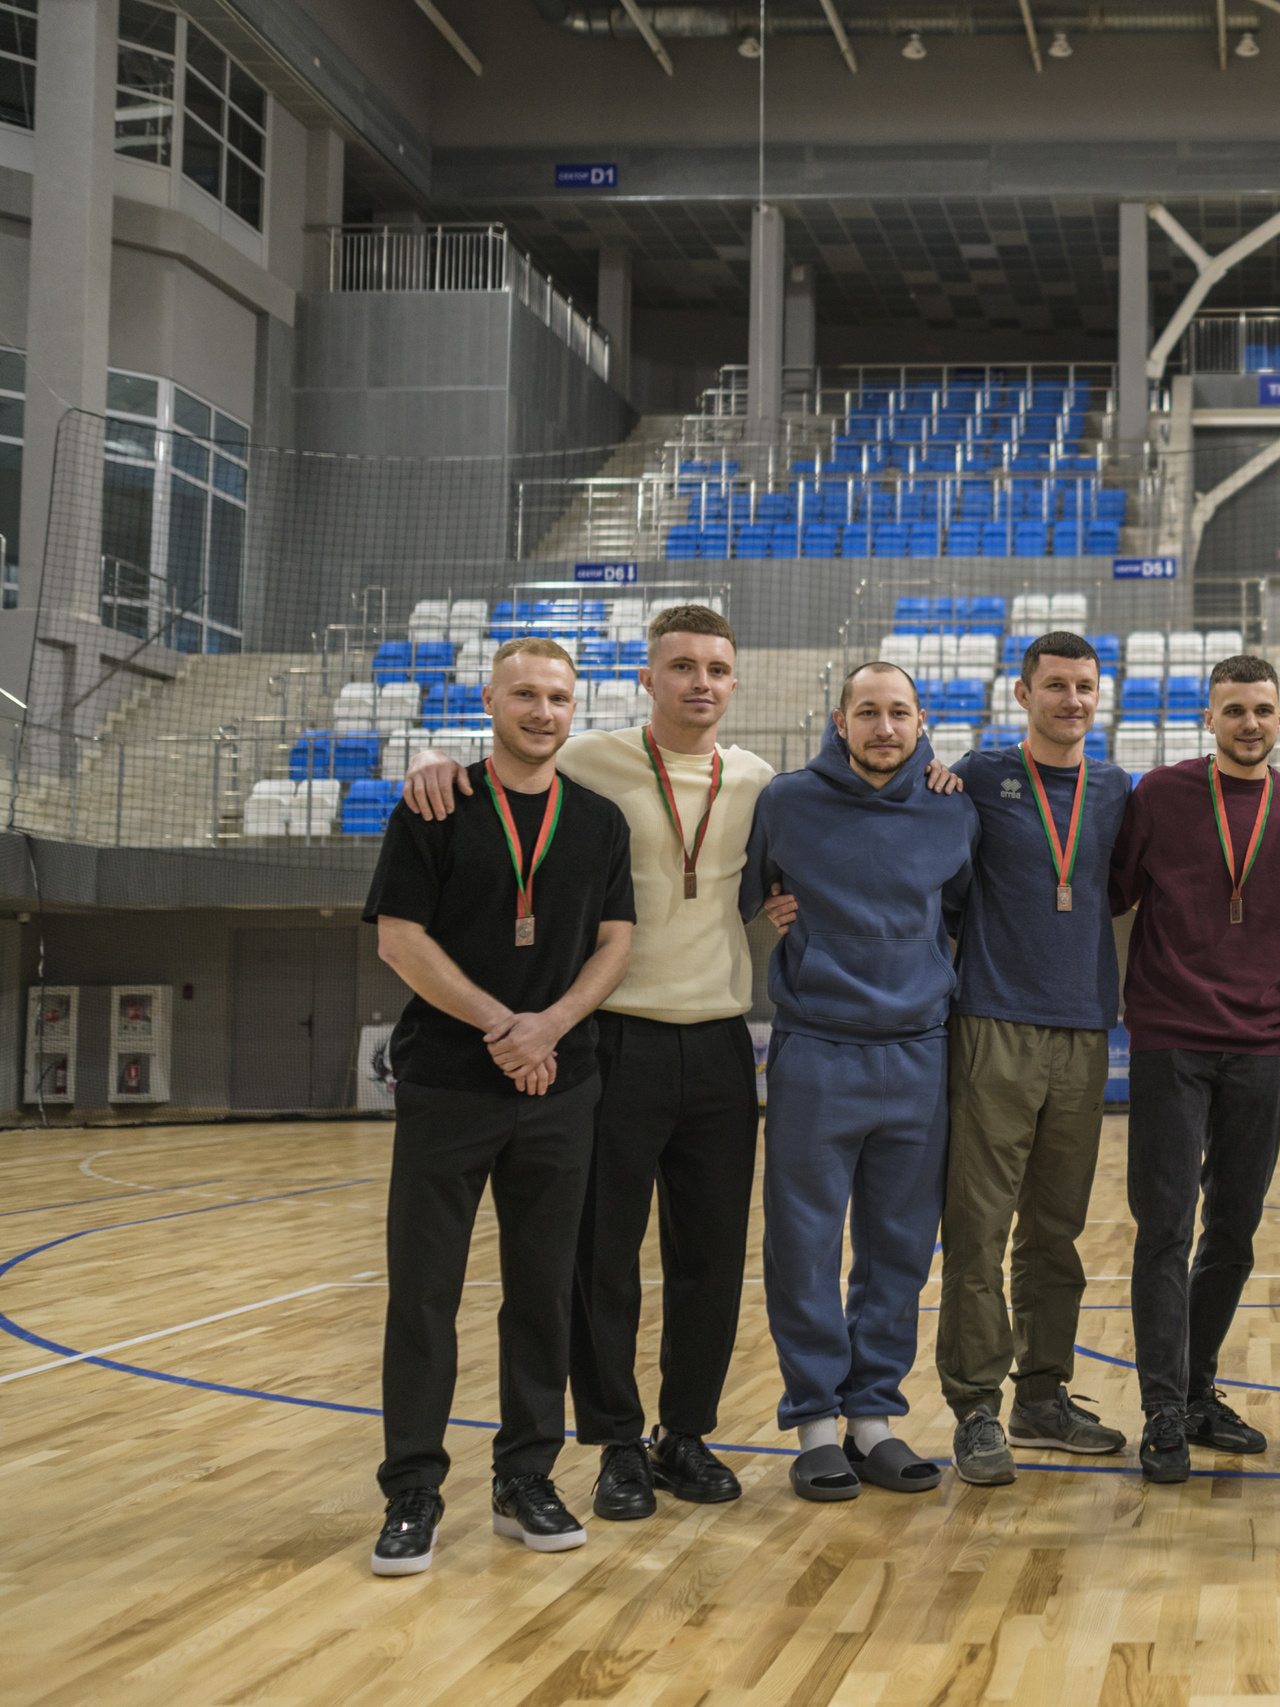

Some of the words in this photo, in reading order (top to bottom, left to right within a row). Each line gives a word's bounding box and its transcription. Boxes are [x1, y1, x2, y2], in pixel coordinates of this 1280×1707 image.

[590, 167, 615, 185] D1
[604, 566, 625, 581] D6
[1142, 560, 1163, 576] D5
